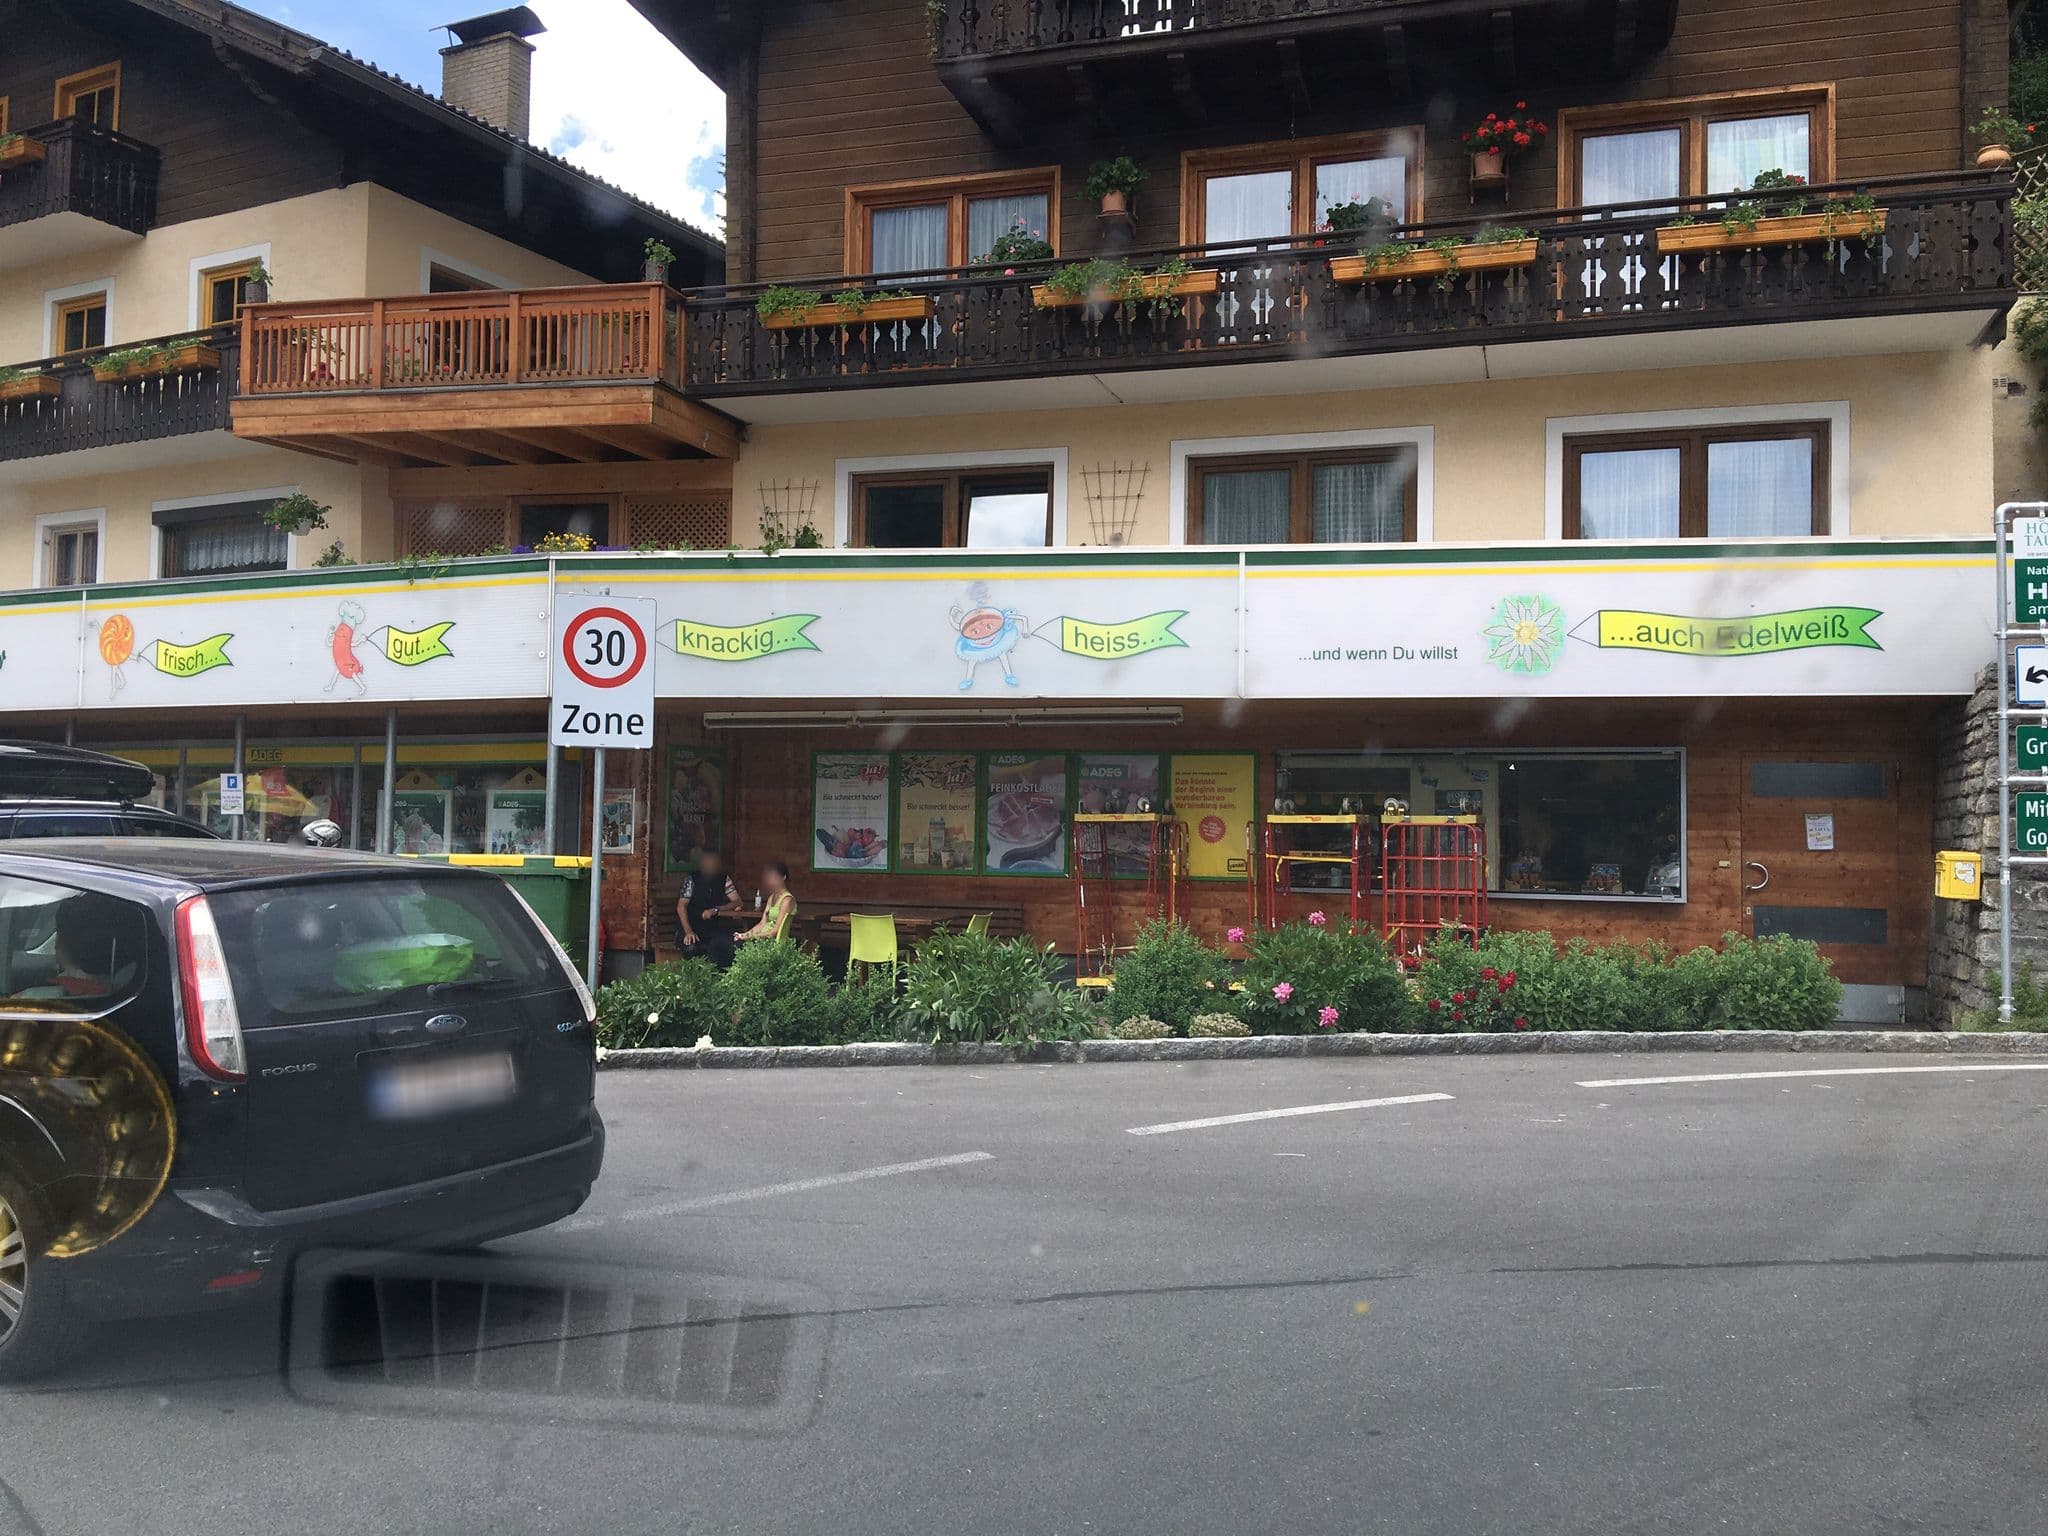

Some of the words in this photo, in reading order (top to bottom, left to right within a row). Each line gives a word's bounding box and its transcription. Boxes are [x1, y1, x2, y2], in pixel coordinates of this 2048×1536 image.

[682, 624, 796, 654] knackig...
[1074, 626, 1163, 653] heiss...
[1610, 623, 1705, 649] ...auch
[1715, 614, 1850, 650] Edelweiß
[392, 637, 436, 659] gut...
[584, 629, 626, 667] 30
[1298, 647, 1341, 661] ...und
[1345, 649, 1388, 661] wenn
[1392, 646, 1415, 660] Du
[1419, 646, 1458, 660] willst
[163, 648, 218, 671] frisch...
[561, 704, 644, 735] Zone
[2026, 737, 2048, 755] Gr
[251, 750, 281, 762] ADEG
[998, 755, 1026, 764] ADEG
[1089, 767, 1122, 777] ADEG
[229, 778, 236, 787] P
[2026, 828, 2048, 846] Go
[261, 1063, 319, 1077] FOCUS
